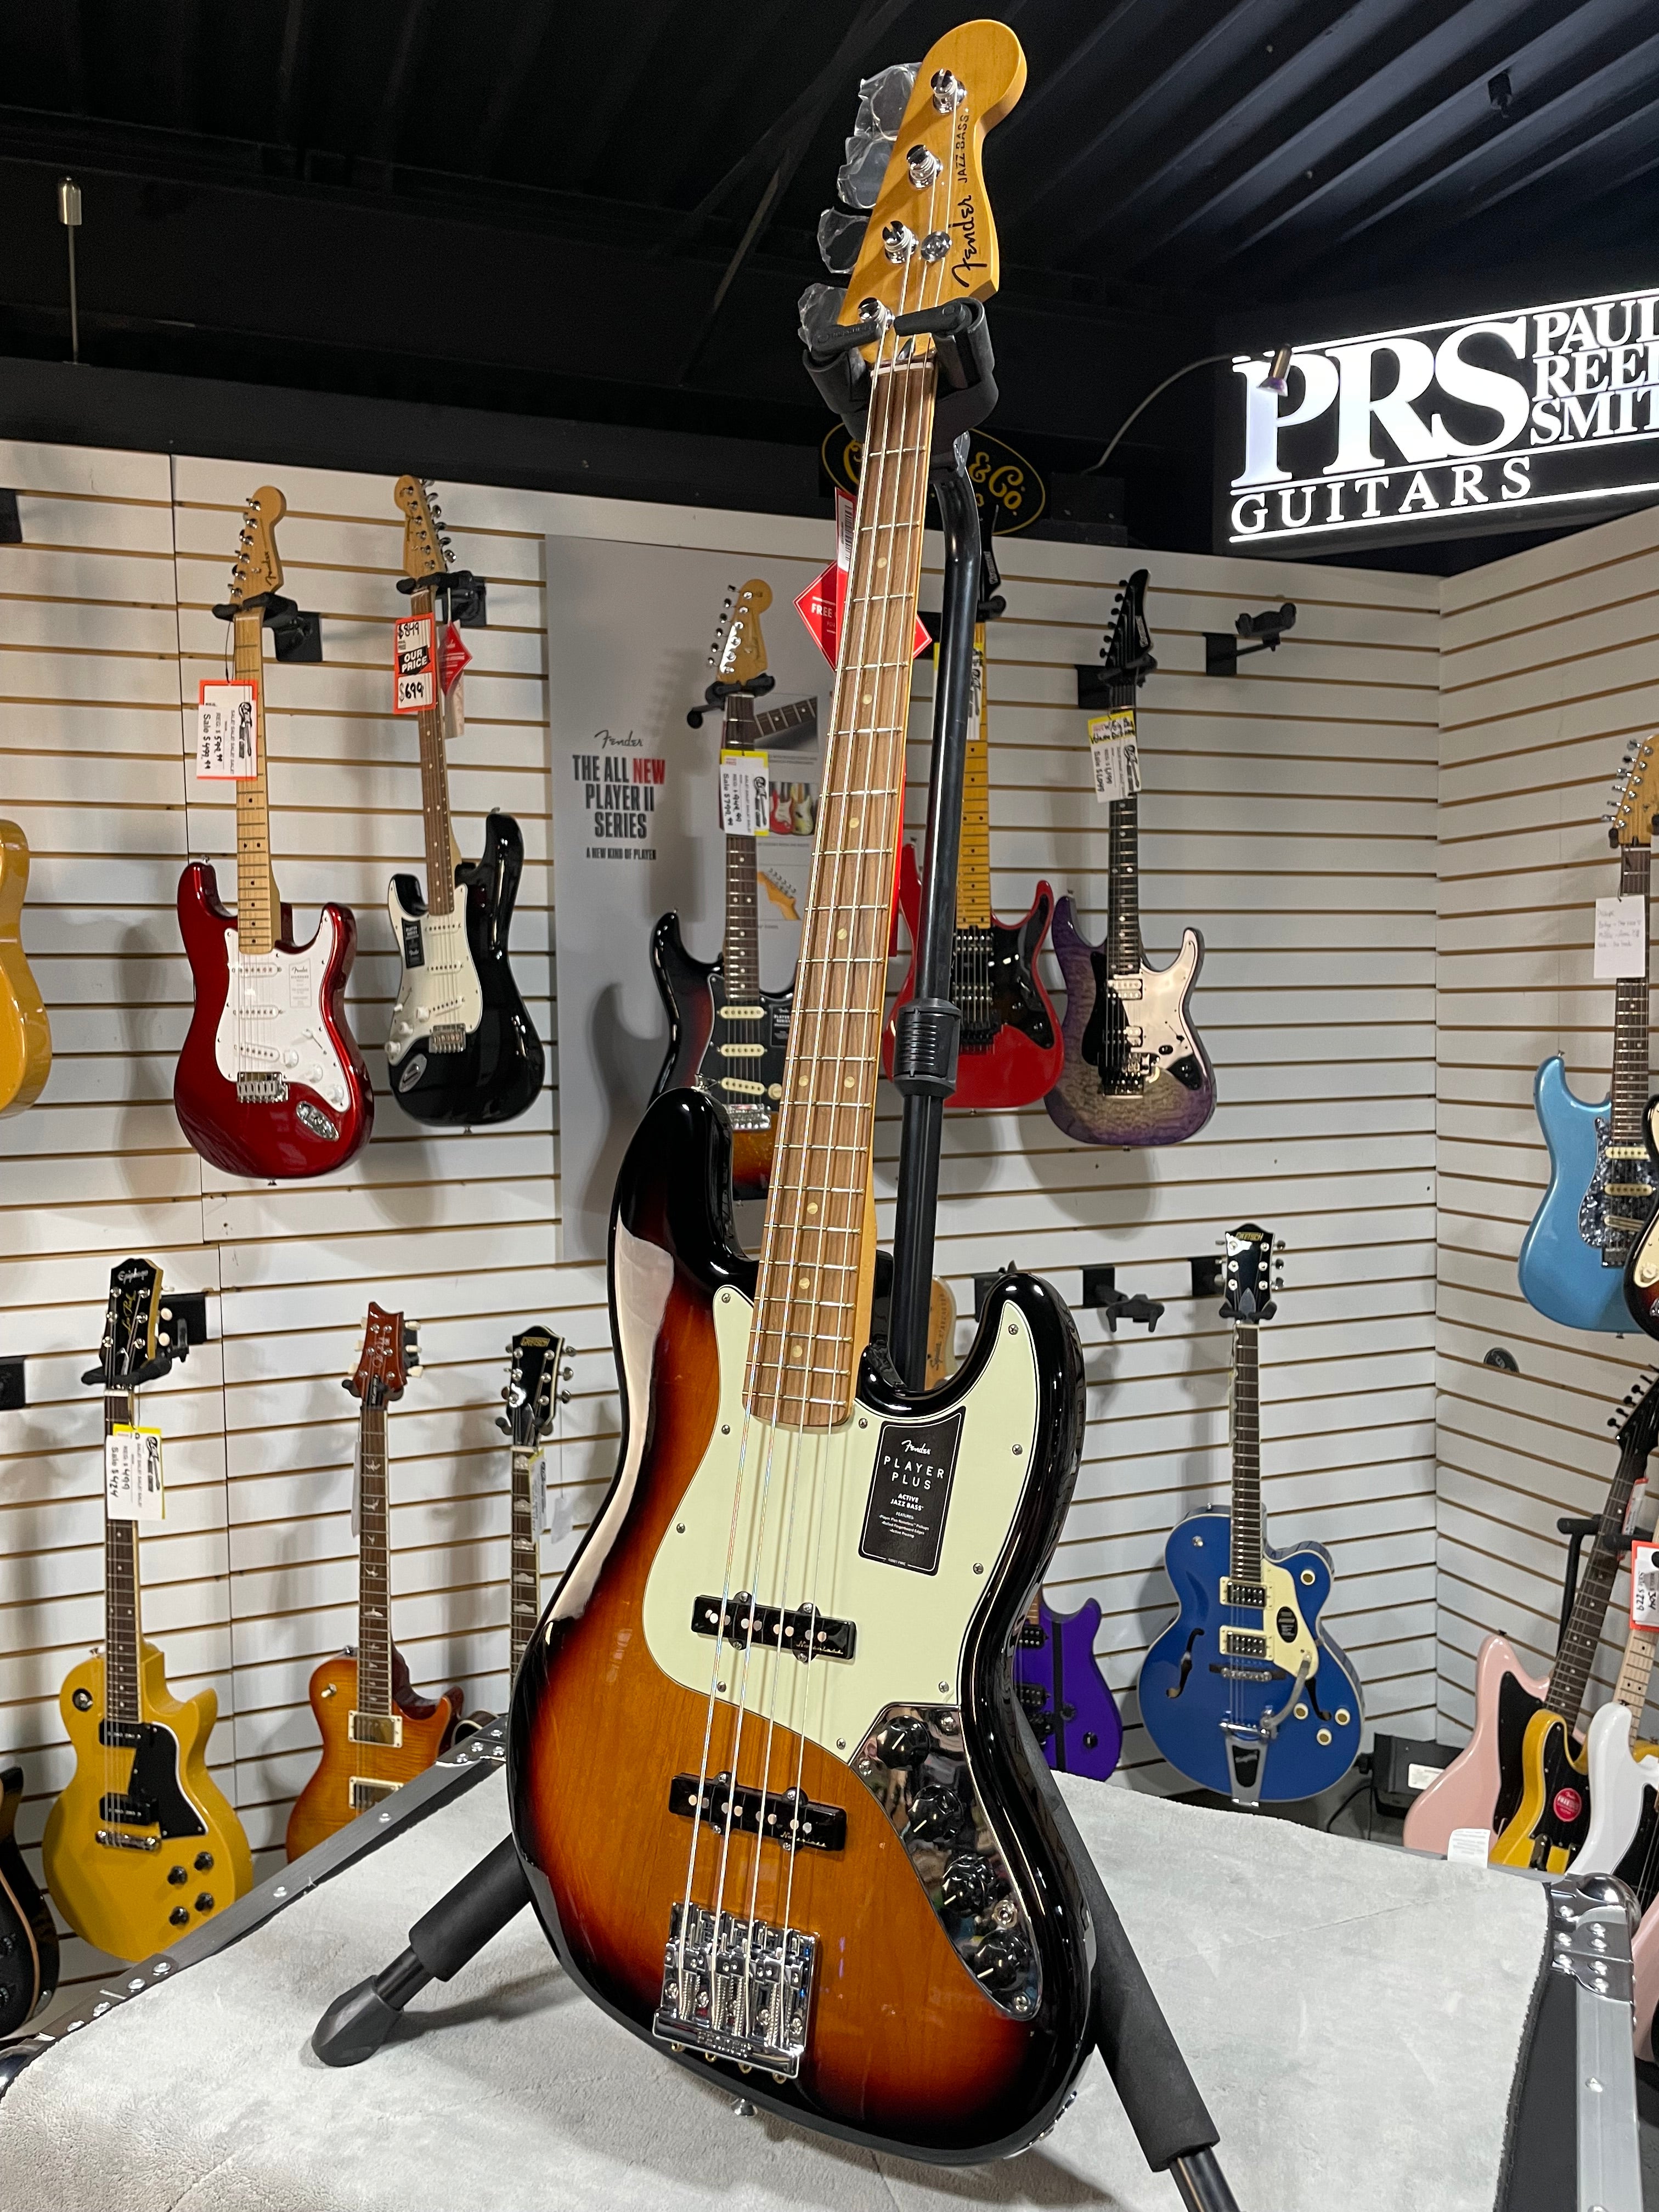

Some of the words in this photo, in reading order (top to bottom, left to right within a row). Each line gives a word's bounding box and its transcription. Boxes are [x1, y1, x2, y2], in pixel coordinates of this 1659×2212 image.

[956, 115, 969, 149] BASS
[956, 153, 967, 183] JAZZ
[949, 195, 987, 287] Fender
[1231, 316, 1530, 488] PRS
[1231, 455, 1531, 534] GUITARS
[811, 603, 833, 618] FREE
[398, 622, 419, 639] $849
[402, 656, 427, 673] PRICE
[404, 648, 423, 662] OUR
[399, 681, 424, 702] $699
[594, 729, 643, 748] Fender
[573, 754, 600, 782] THE
[604, 756, 629, 783] ALL
[633, 758, 665, 785] NEW
[585, 783, 641, 811] PLAYER
[595, 812, 647, 839] SERIES
[586, 847, 591, 859] A
[592, 848, 606, 859] NEW
[607, 848, 623, 860] KIND
[624, 849, 633, 860] OF
[634, 849, 657, 861] PLAYER
[901, 1440, 932, 1455] Fender
[883, 1455, 945, 1479] PLAYER
[891, 1471, 932, 1491] PLUS
[890, 1499, 905, 1507] JAZZ
[898, 1493, 919, 1503] ACTIVE
